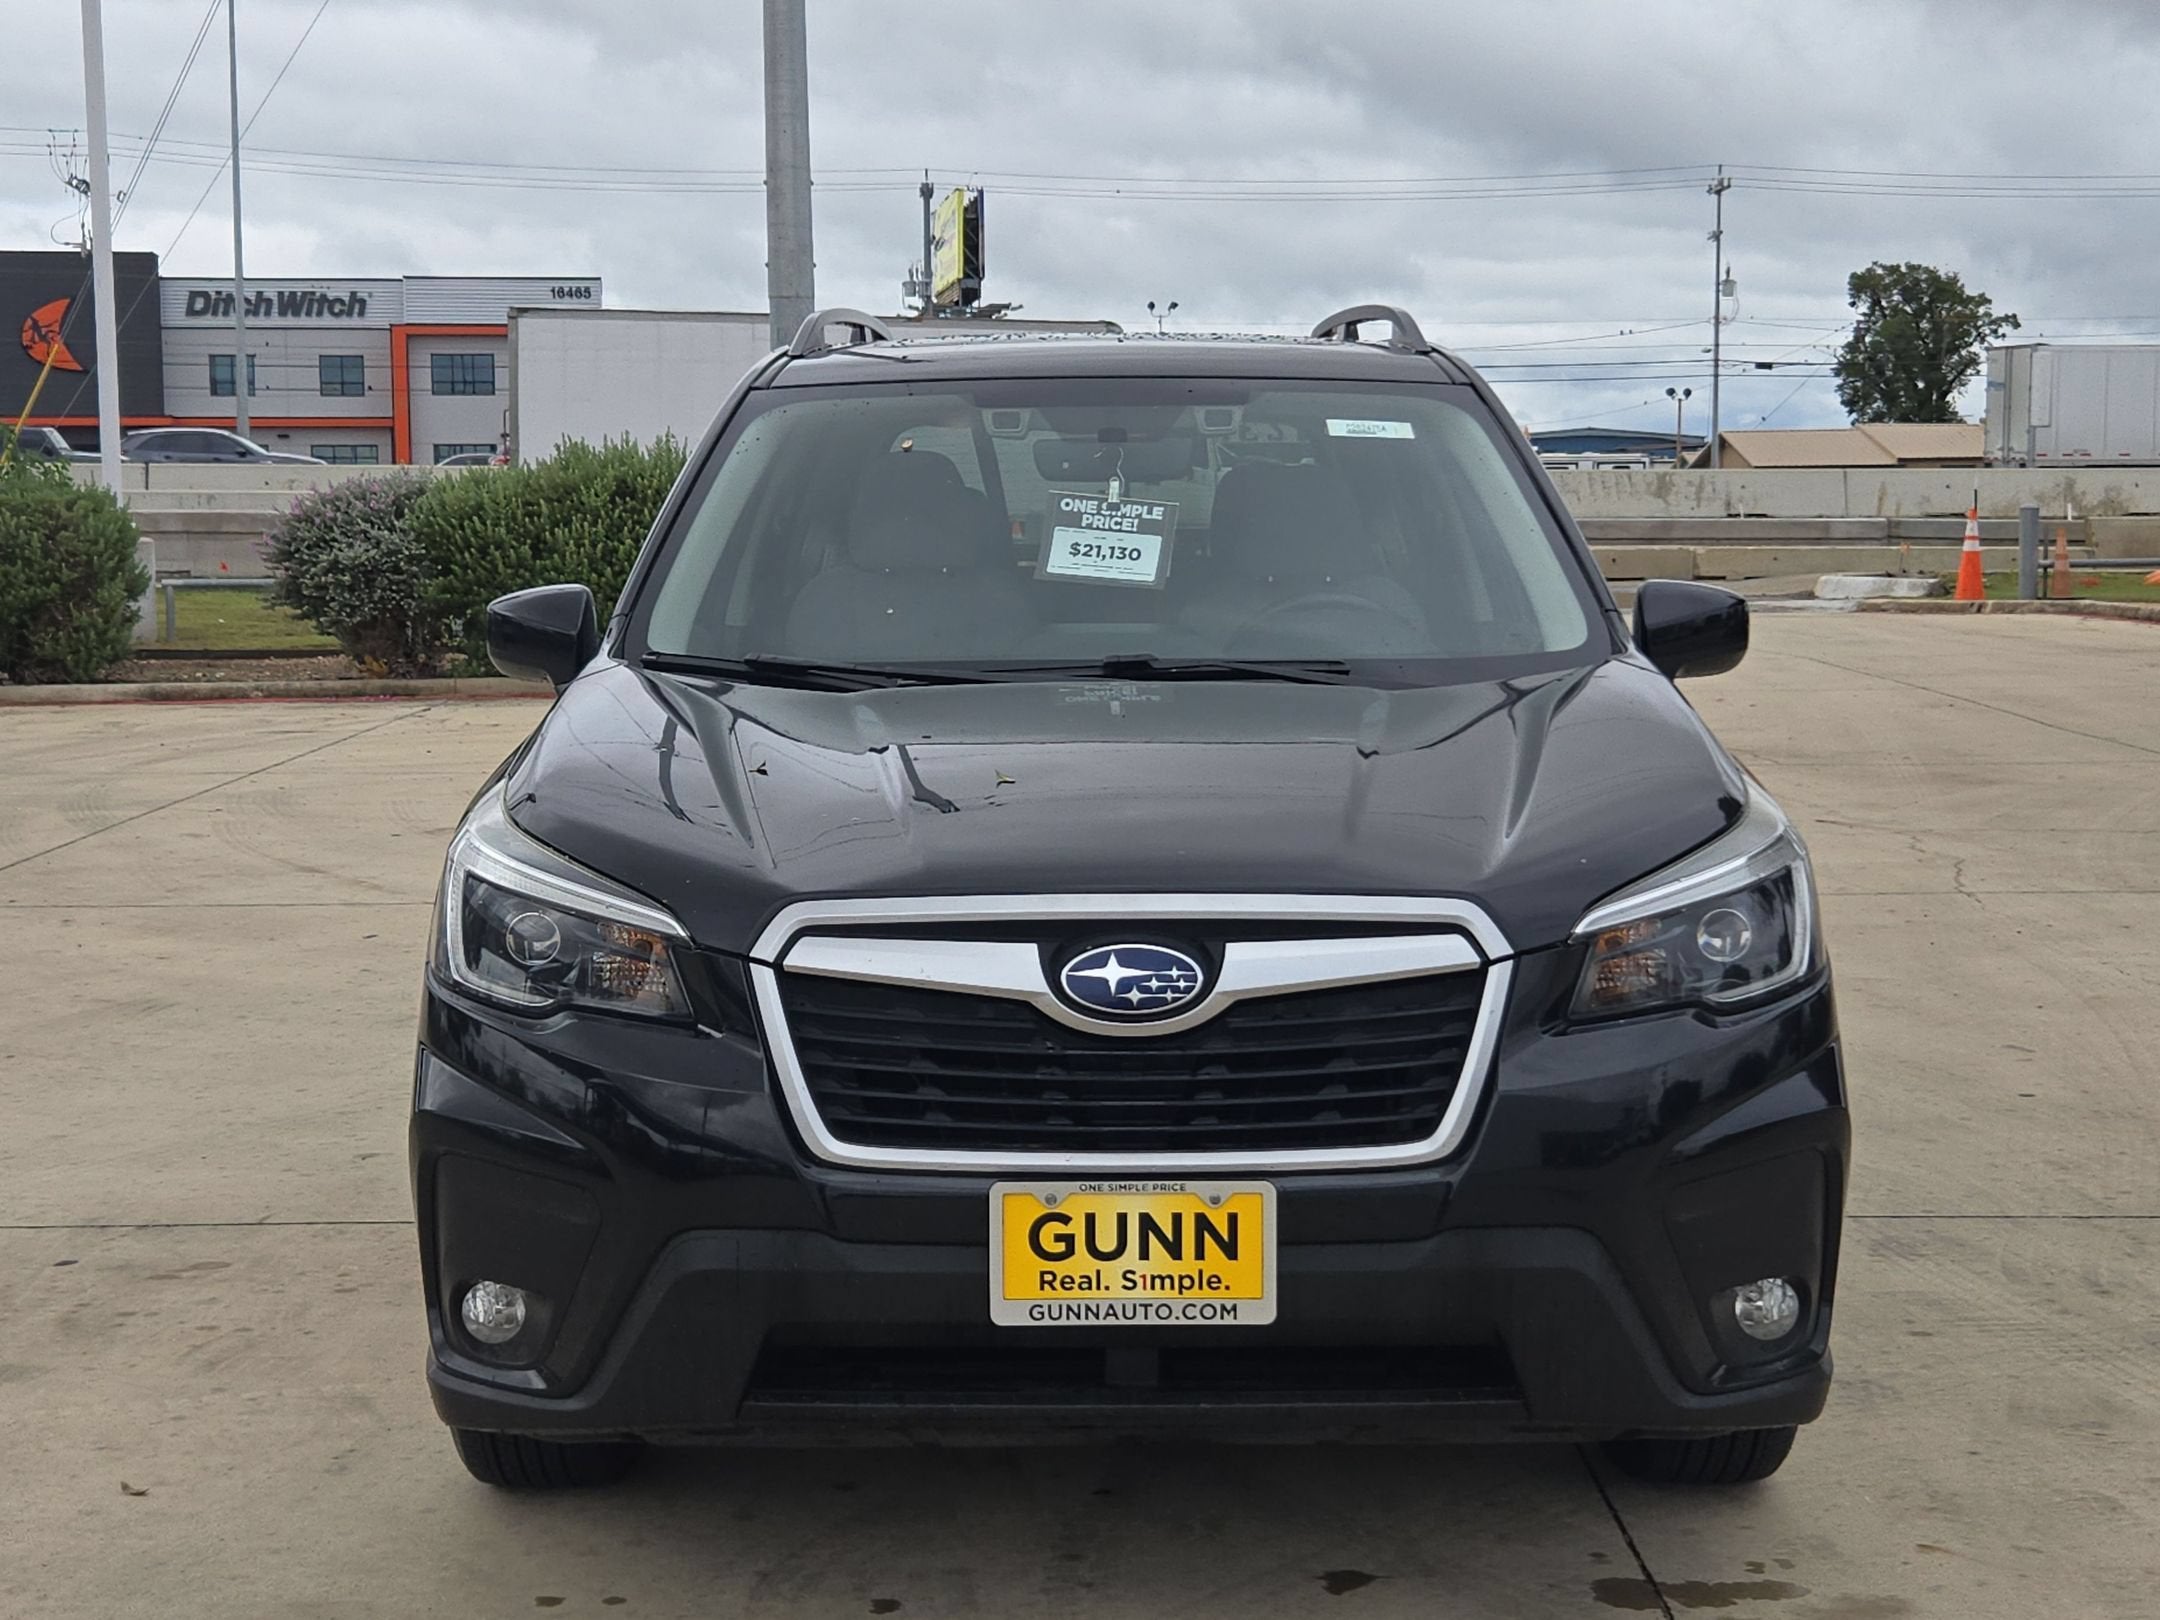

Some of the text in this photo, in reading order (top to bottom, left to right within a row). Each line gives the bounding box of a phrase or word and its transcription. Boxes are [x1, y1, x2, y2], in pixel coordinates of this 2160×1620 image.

[550, 286, 592, 299] 16465
[276, 290, 368, 318] Witch
[1060, 498, 1164, 520] ONE SMPLE
[1081, 514, 1139, 532] PRICE!
[1069, 541, 1142, 561] $21,130
[1079, 1183, 1187, 1192] ONE SIMPLE PRICE
[1028, 1212, 1239, 1262] GUNN
[1039, 1269, 1110, 1291] Real.
[1029, 1303, 1238, 1321] GUNNAUTO.COM
